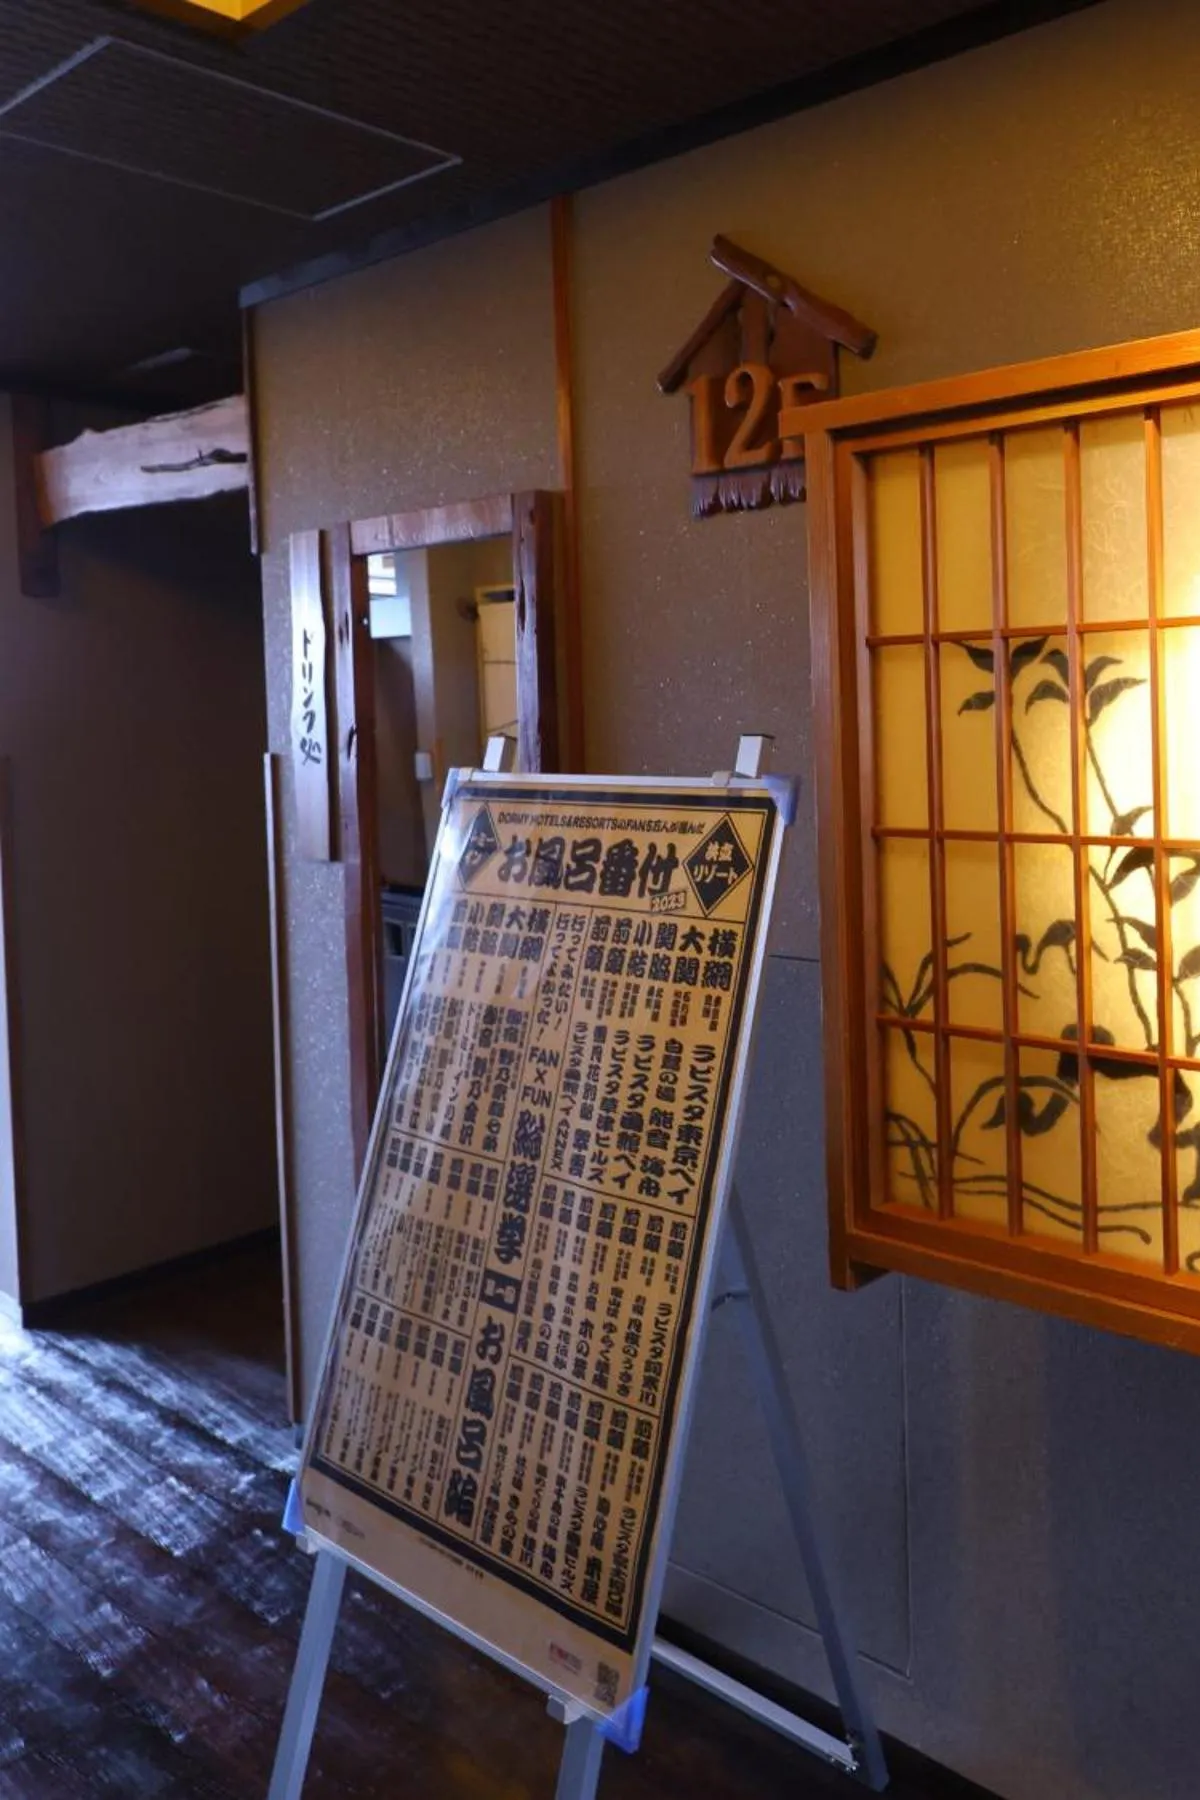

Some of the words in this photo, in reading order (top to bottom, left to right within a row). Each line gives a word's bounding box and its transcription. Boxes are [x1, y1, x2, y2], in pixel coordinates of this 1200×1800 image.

[496, 833, 680, 899] お風呂番付
[693, 861, 740, 885] リゾート
[583, 913, 612, 972] 前頭
[603, 916, 633, 975] 前頭
[625, 919, 653, 979] 小結
[647, 921, 678, 982] 関脇
[672, 924, 705, 986] 大関
[527, 1045, 560, 1069] FAN
[520, 1084, 553, 1109] FUN
[667, 1043, 715, 1205] ラビスタ東京ベイ
